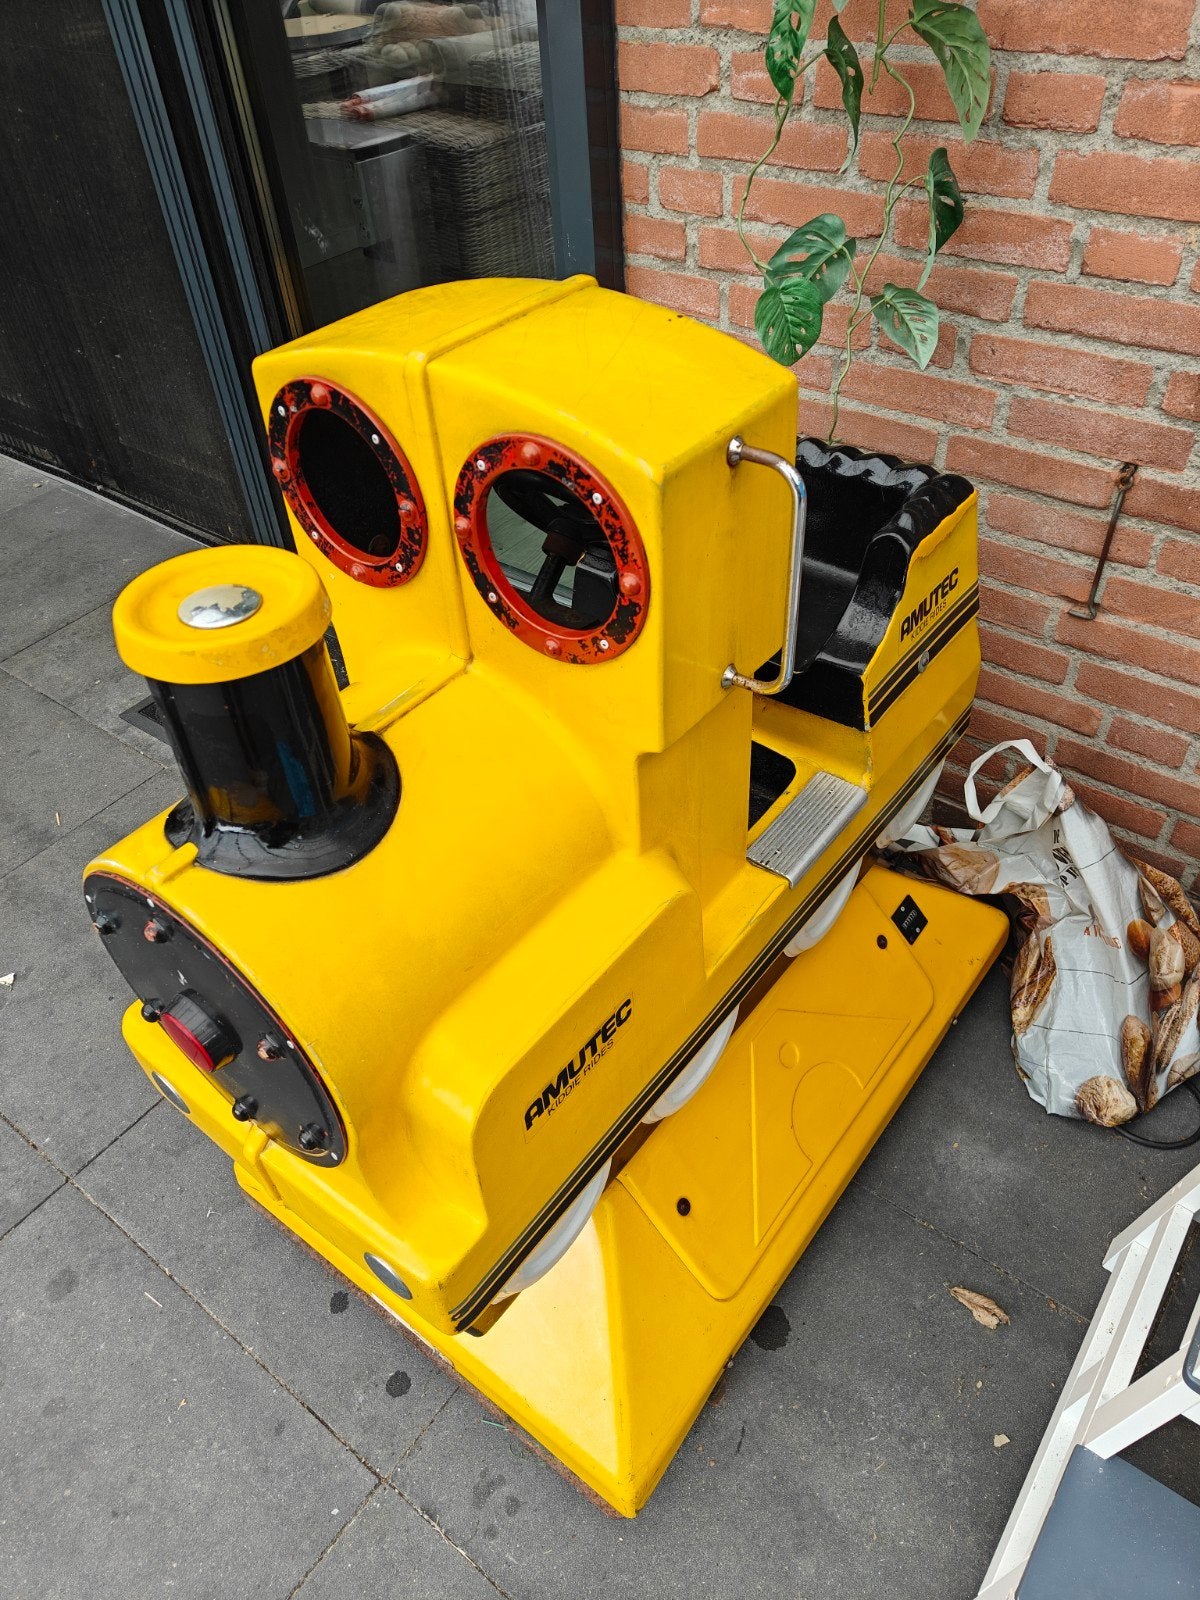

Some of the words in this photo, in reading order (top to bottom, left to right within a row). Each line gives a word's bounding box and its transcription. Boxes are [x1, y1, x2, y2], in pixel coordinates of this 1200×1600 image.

[901, 567, 958, 642] AMUTEC
[930, 599, 947, 620] RIDES
[524, 998, 632, 1131] AMUTEC
[547, 1075, 581, 1116] KIDDIE
[583, 1038, 614, 1076] RIDES
